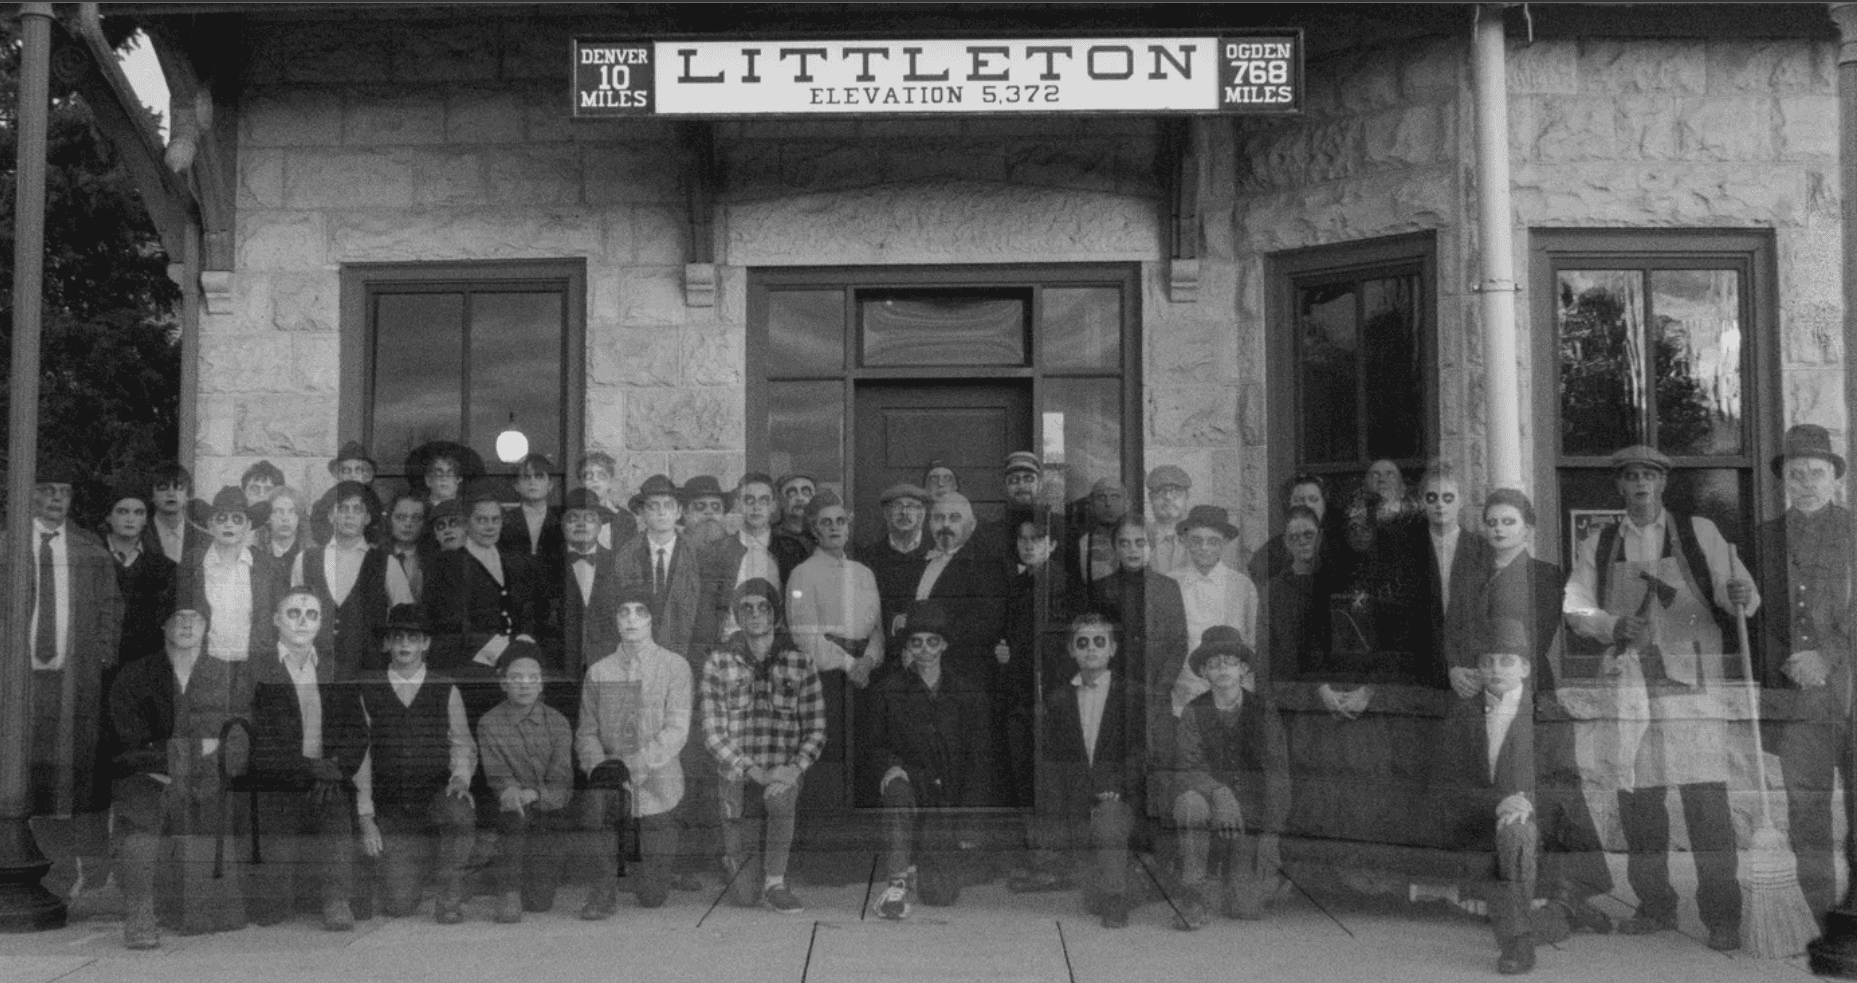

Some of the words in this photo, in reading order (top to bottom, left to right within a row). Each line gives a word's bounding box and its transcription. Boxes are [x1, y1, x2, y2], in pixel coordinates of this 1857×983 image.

[580, 48, 648, 64] DENVER
[1226, 43, 1291, 59] OGDEN
[677, 44, 1197, 84] LITTLETON
[1230, 61, 1288, 85] 768
[598, 65, 630, 90] 10
[580, 90, 648, 107] MILES
[809, 86, 963, 105] ELEVATION
[982, 84, 1060, 105] 5,372
[1224, 86, 1293, 103] MILES
